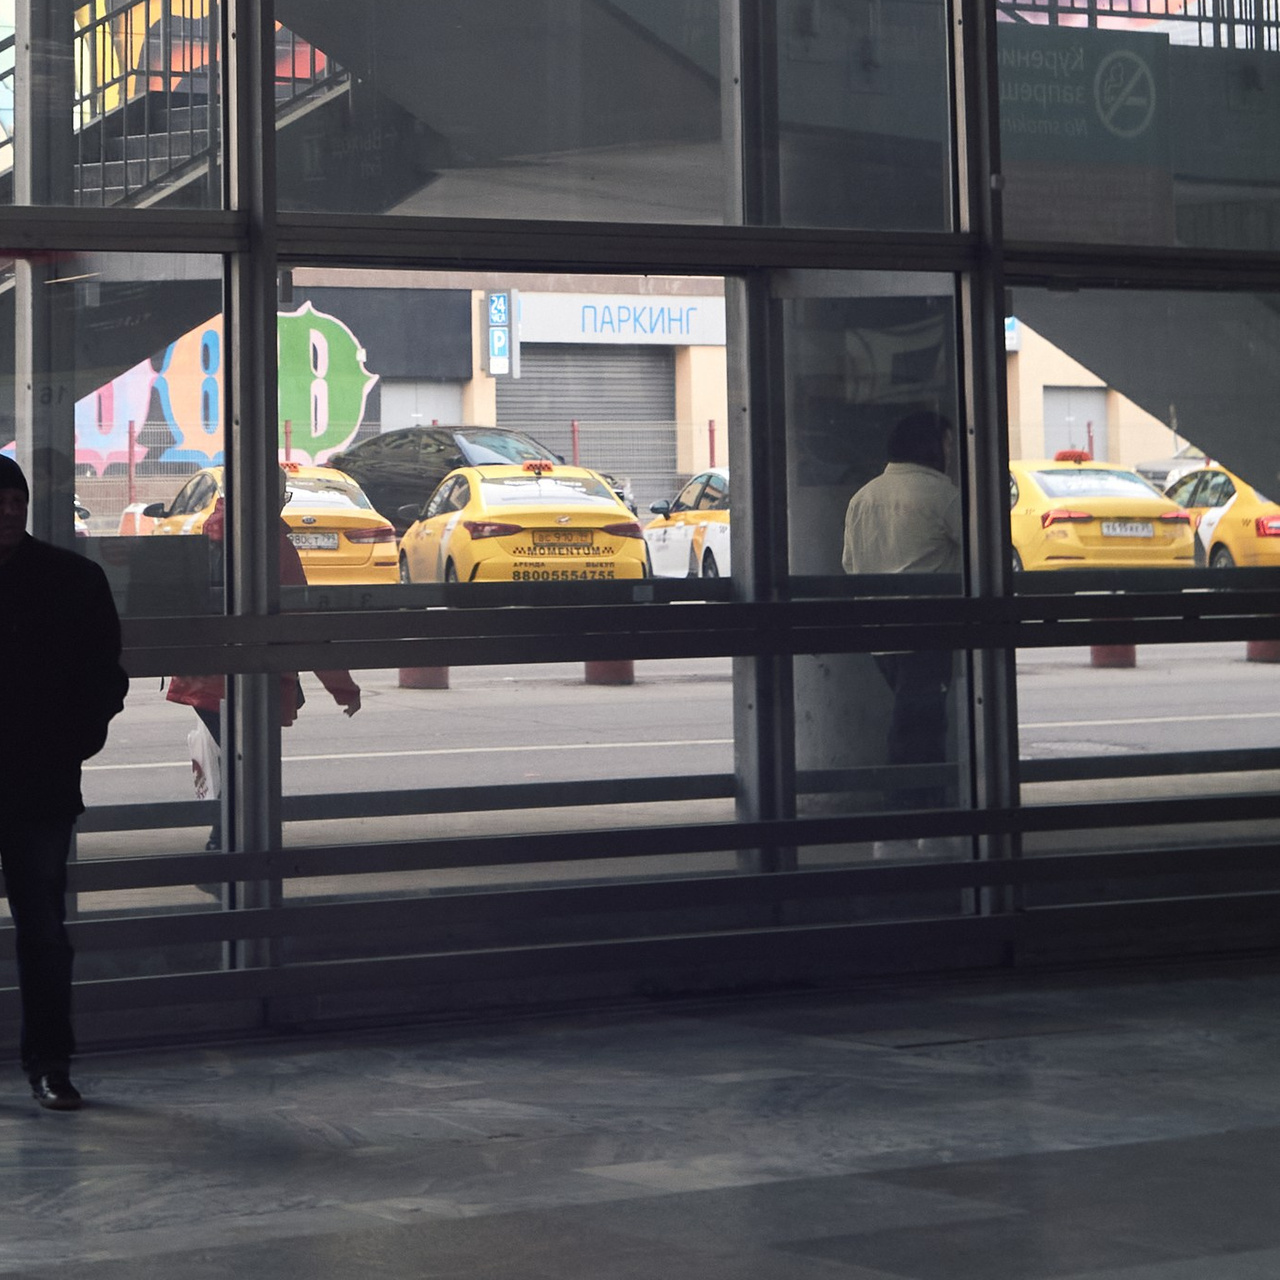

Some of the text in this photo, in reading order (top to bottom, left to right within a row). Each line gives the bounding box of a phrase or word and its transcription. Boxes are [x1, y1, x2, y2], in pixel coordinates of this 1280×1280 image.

[490, 296, 506, 314] 24
[581, 305, 698, 335] ПАРКИНГ
[527, 547, 601, 556] MOMENTUM
[512, 570, 615, 581] 88005554755
